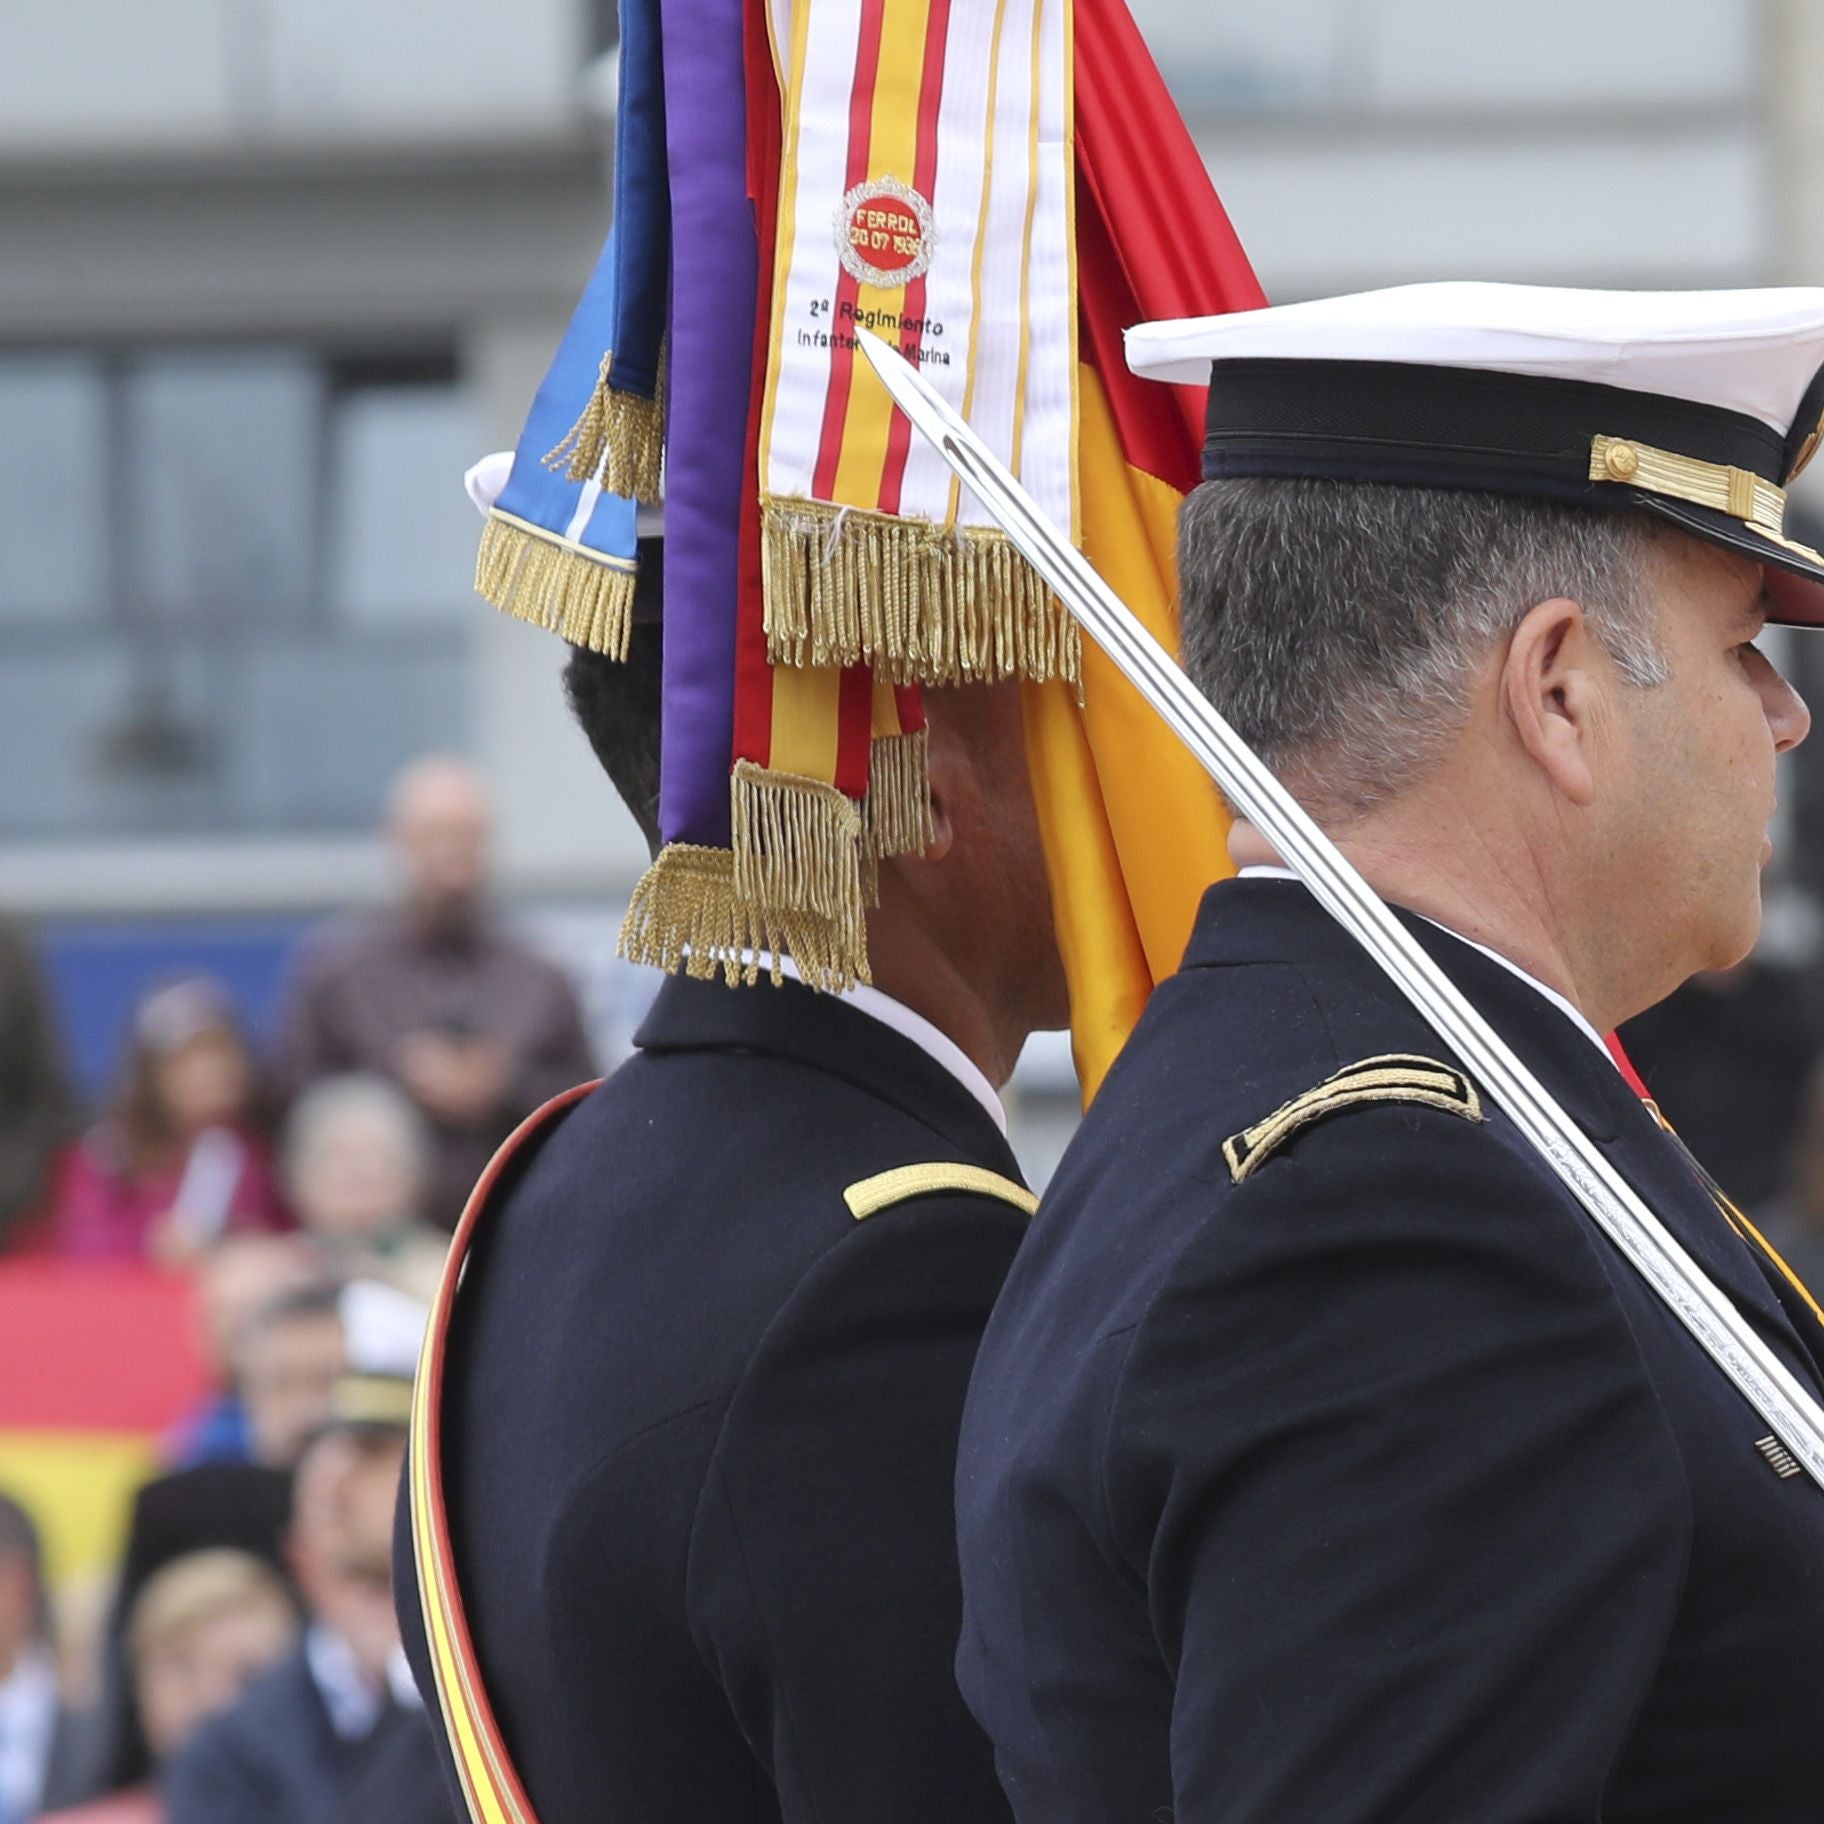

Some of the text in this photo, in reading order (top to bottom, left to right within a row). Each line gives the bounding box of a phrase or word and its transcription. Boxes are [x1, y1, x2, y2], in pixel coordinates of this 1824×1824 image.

[857, 209, 918, 234] FERROL
[871, 230, 890, 251] 07
[840, 301, 944, 337] Regimiento
[797, 329, 860, 352] Infanter
[903, 342, 950, 366] Marina
